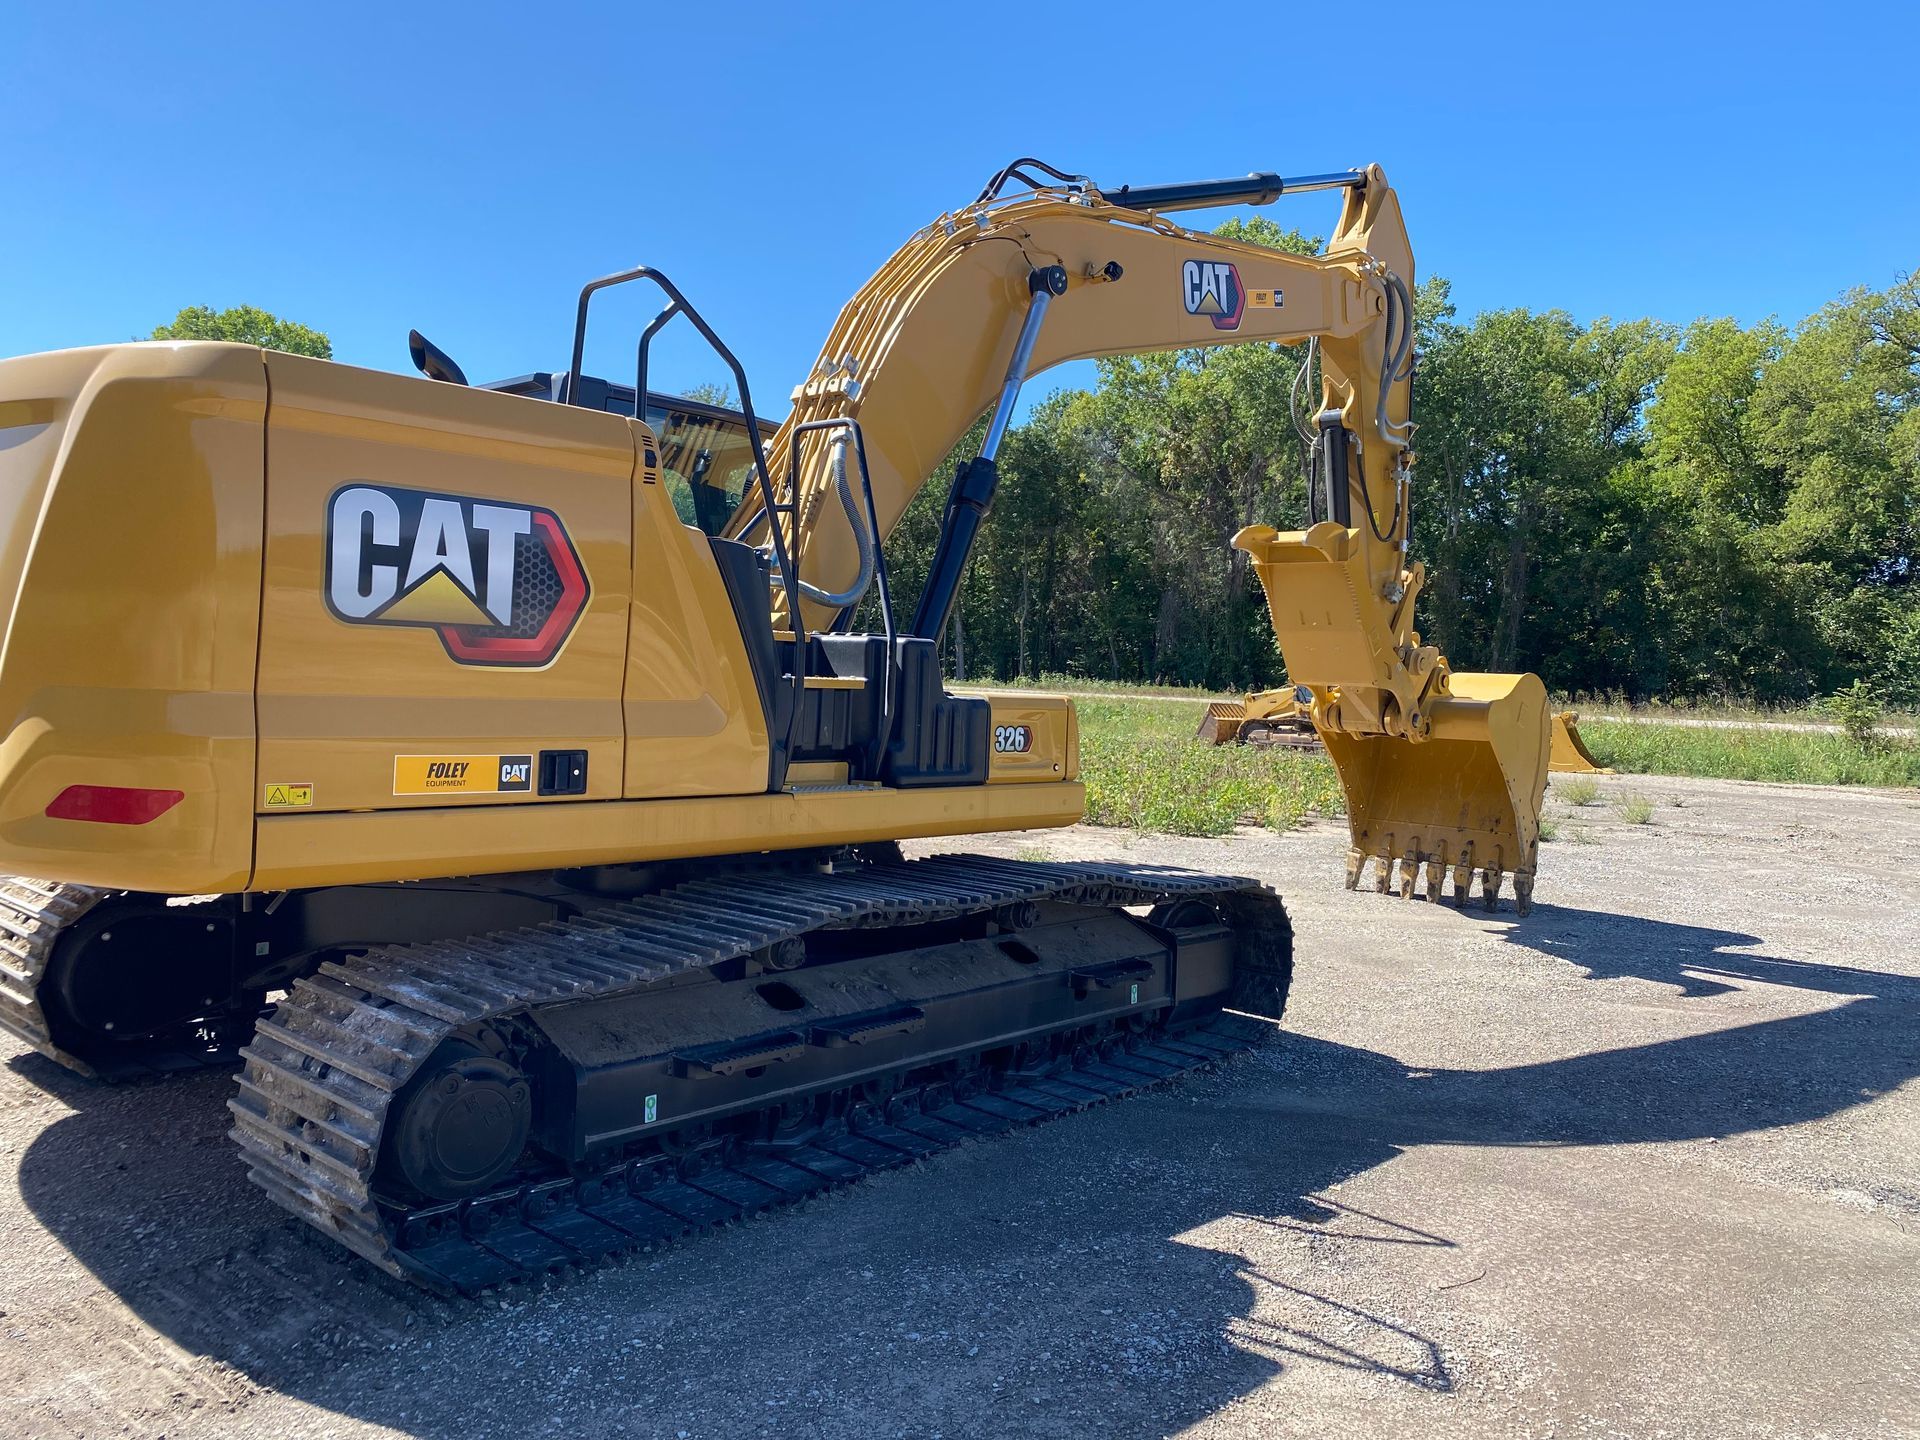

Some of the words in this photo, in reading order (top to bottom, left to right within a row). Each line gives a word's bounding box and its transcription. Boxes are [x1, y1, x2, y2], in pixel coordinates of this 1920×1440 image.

[1183, 261, 1230, 313] CAT
[331, 487, 532, 627] CAT
[995, 726, 1025, 752] 326
[426, 762, 470, 778] FOLEY
[501, 764, 528, 783] CAT
[425, 779, 466, 788] EQUIPMENT
